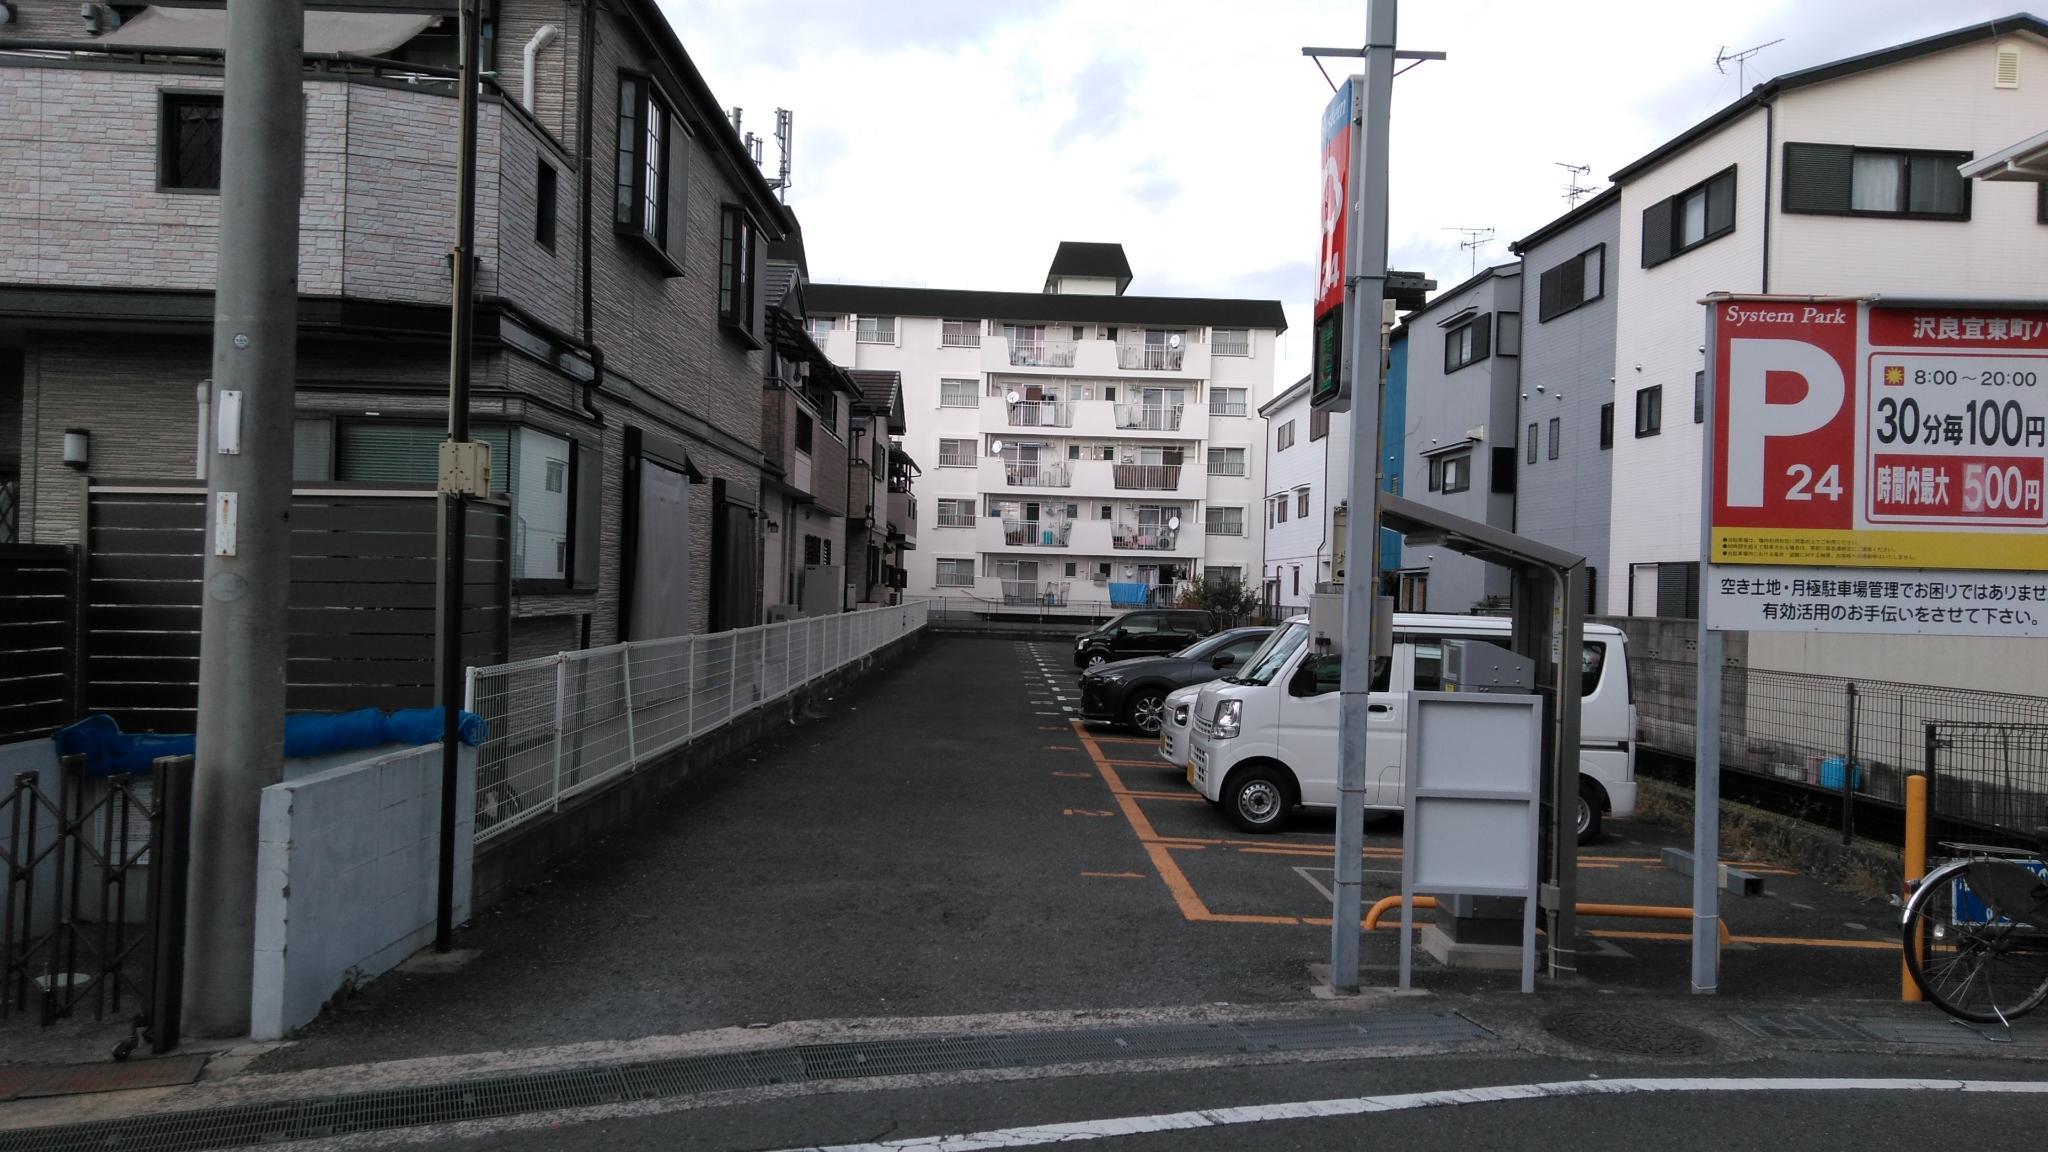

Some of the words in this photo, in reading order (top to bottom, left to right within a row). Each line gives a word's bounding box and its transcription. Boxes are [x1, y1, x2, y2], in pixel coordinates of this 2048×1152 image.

[1726, 306, 1794, 327] System
[1802, 308, 1846, 325] Park
[1727, 338, 1846, 508] P
[1877, 397, 2045, 448] 30分毎100円
[1785, 464, 1843, 502] 24
[1877, 466, 1949, 506] 時間内最大
[1963, 465, 2040, 511] 500円
[1721, 579, 2048, 602] 空き土地・月極駐車場管理でお困りではありませ
[1763, 604, 2039, 626] 有効活用のお手伝いをさせて下さい。
